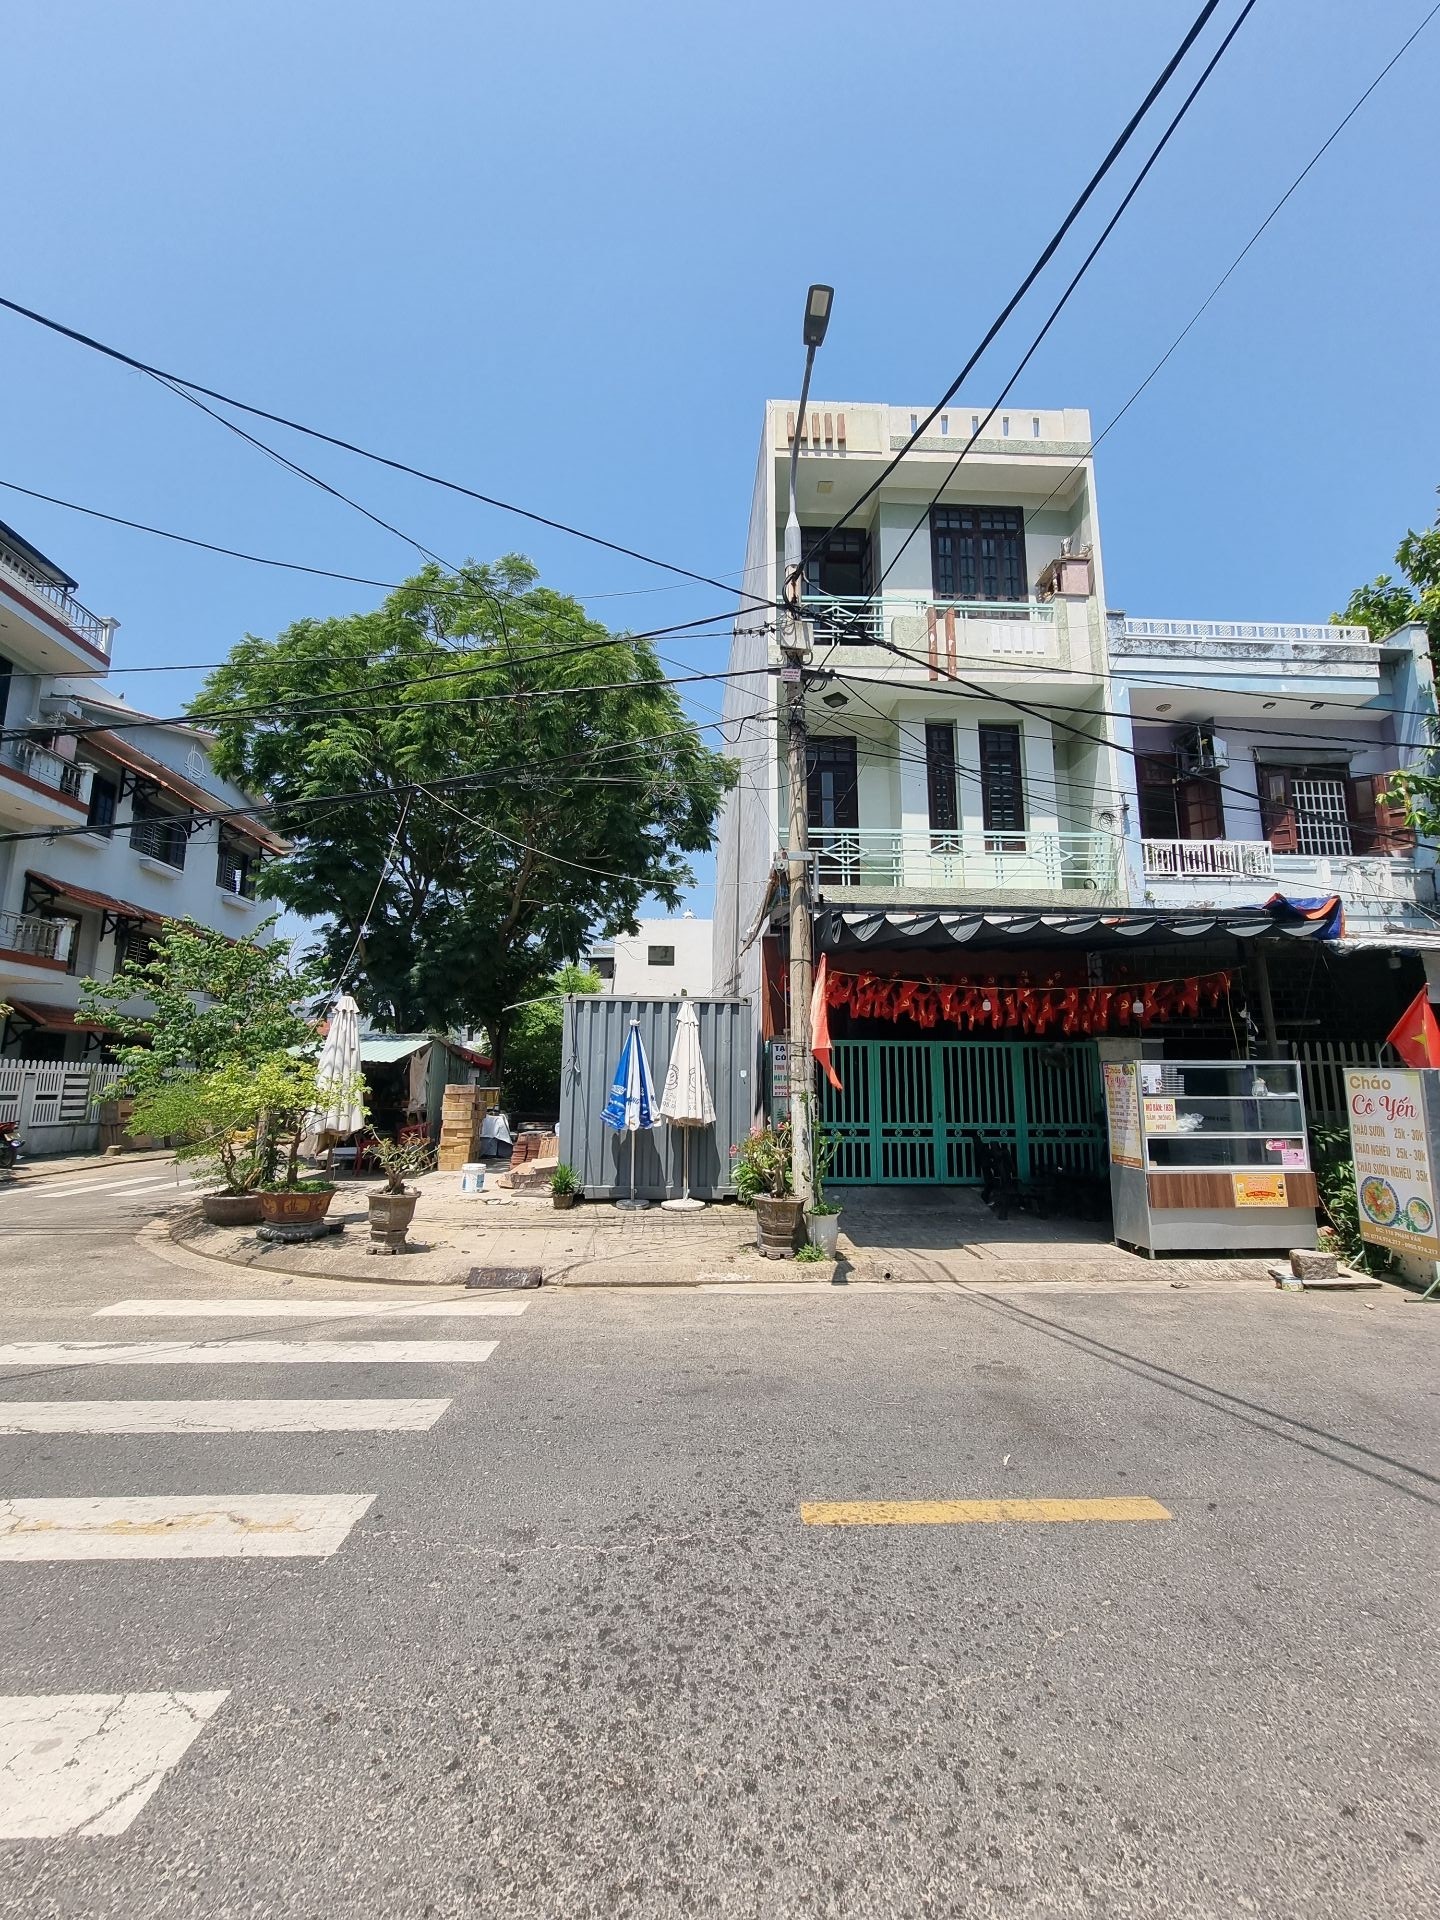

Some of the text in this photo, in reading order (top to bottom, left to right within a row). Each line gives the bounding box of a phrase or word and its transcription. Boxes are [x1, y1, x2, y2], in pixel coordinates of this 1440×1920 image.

[1349, 1075, 1392, 1091] Cháo
[1352, 1094, 1417, 1121] Cô Yến
